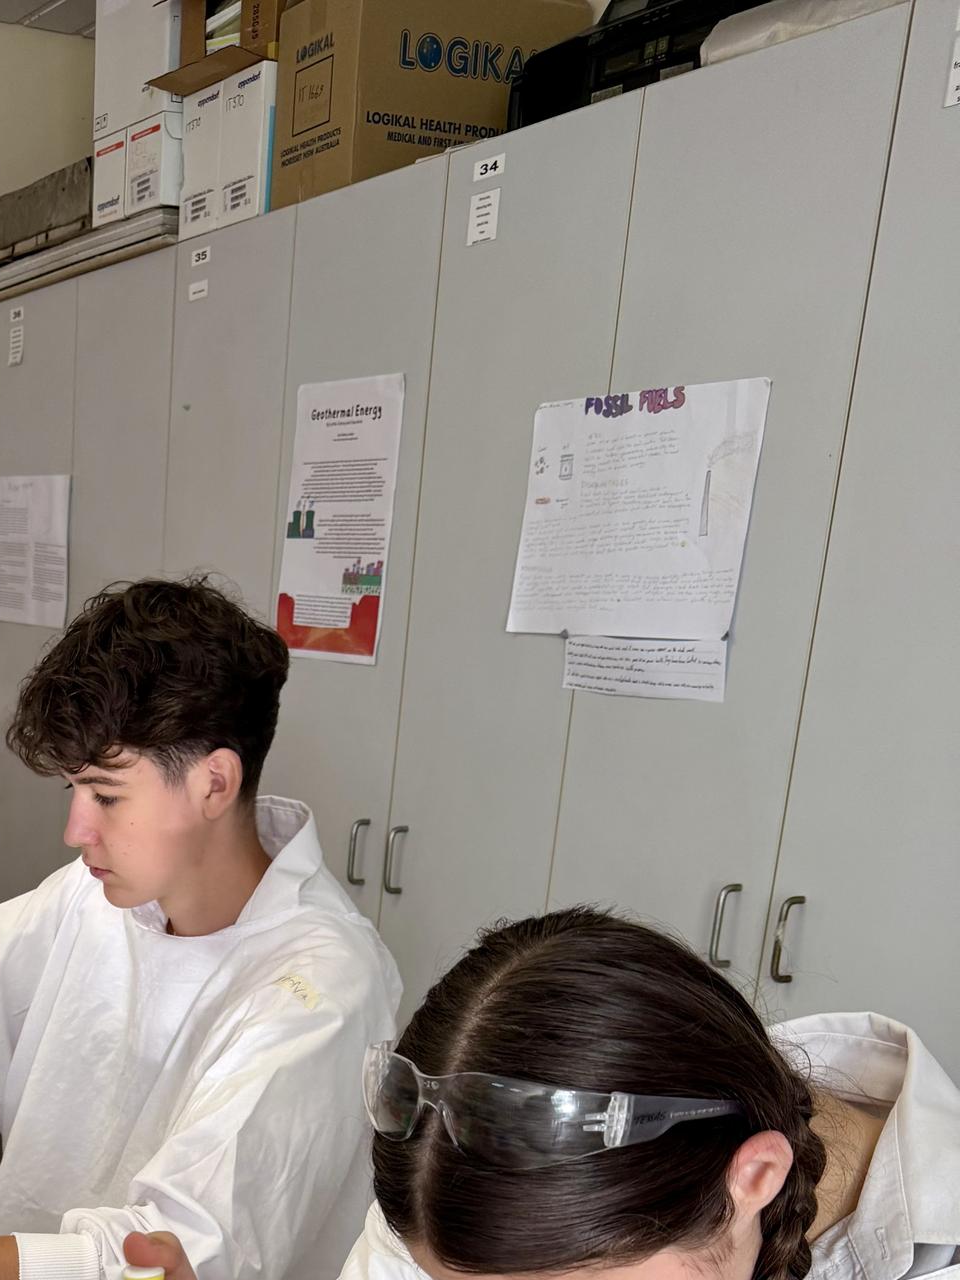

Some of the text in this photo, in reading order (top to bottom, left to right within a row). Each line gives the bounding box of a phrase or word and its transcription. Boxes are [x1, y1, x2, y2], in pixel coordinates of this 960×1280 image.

[295, 32, 335, 64] LOGIKAL
[399, 29, 538, 84] LOGIKA
[366, 110, 506, 139] LOGIKAL HEALTH PRODU
[387, 131, 416, 145] MEDICAL
[417, 135, 432, 146] AND
[480, 160, 499, 175] 34
[194, 250, 208, 263] 35
[311, 404, 382, 421] Geothermal Energy
[585, 385, 685, 418] FOSSIL FUELS
